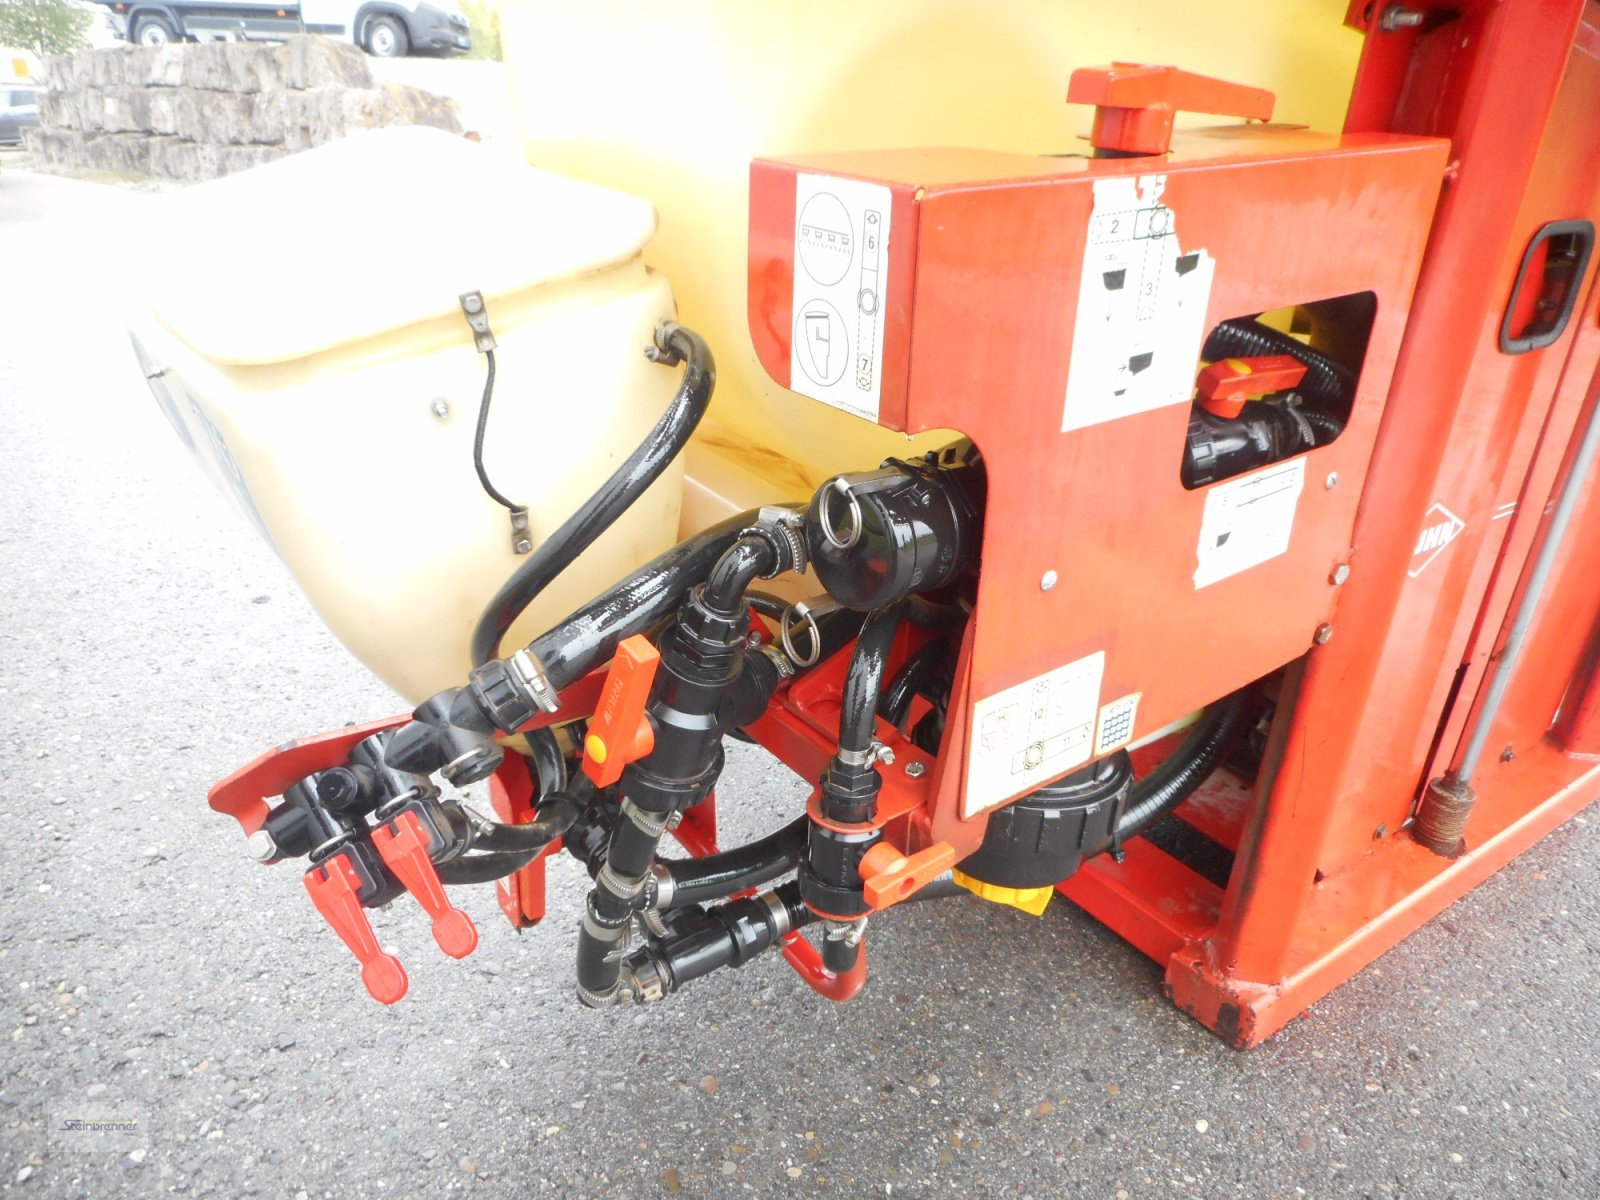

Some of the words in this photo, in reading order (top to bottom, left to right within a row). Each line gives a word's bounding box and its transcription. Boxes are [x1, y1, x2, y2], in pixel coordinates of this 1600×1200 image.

[1110, 219, 1120, 234] 2
[868, 235, 875, 250] 6
[1145, 282, 1153, 297] 3
[861, 358, 869, 372] 7
[1033, 708, 1044, 721] 12
